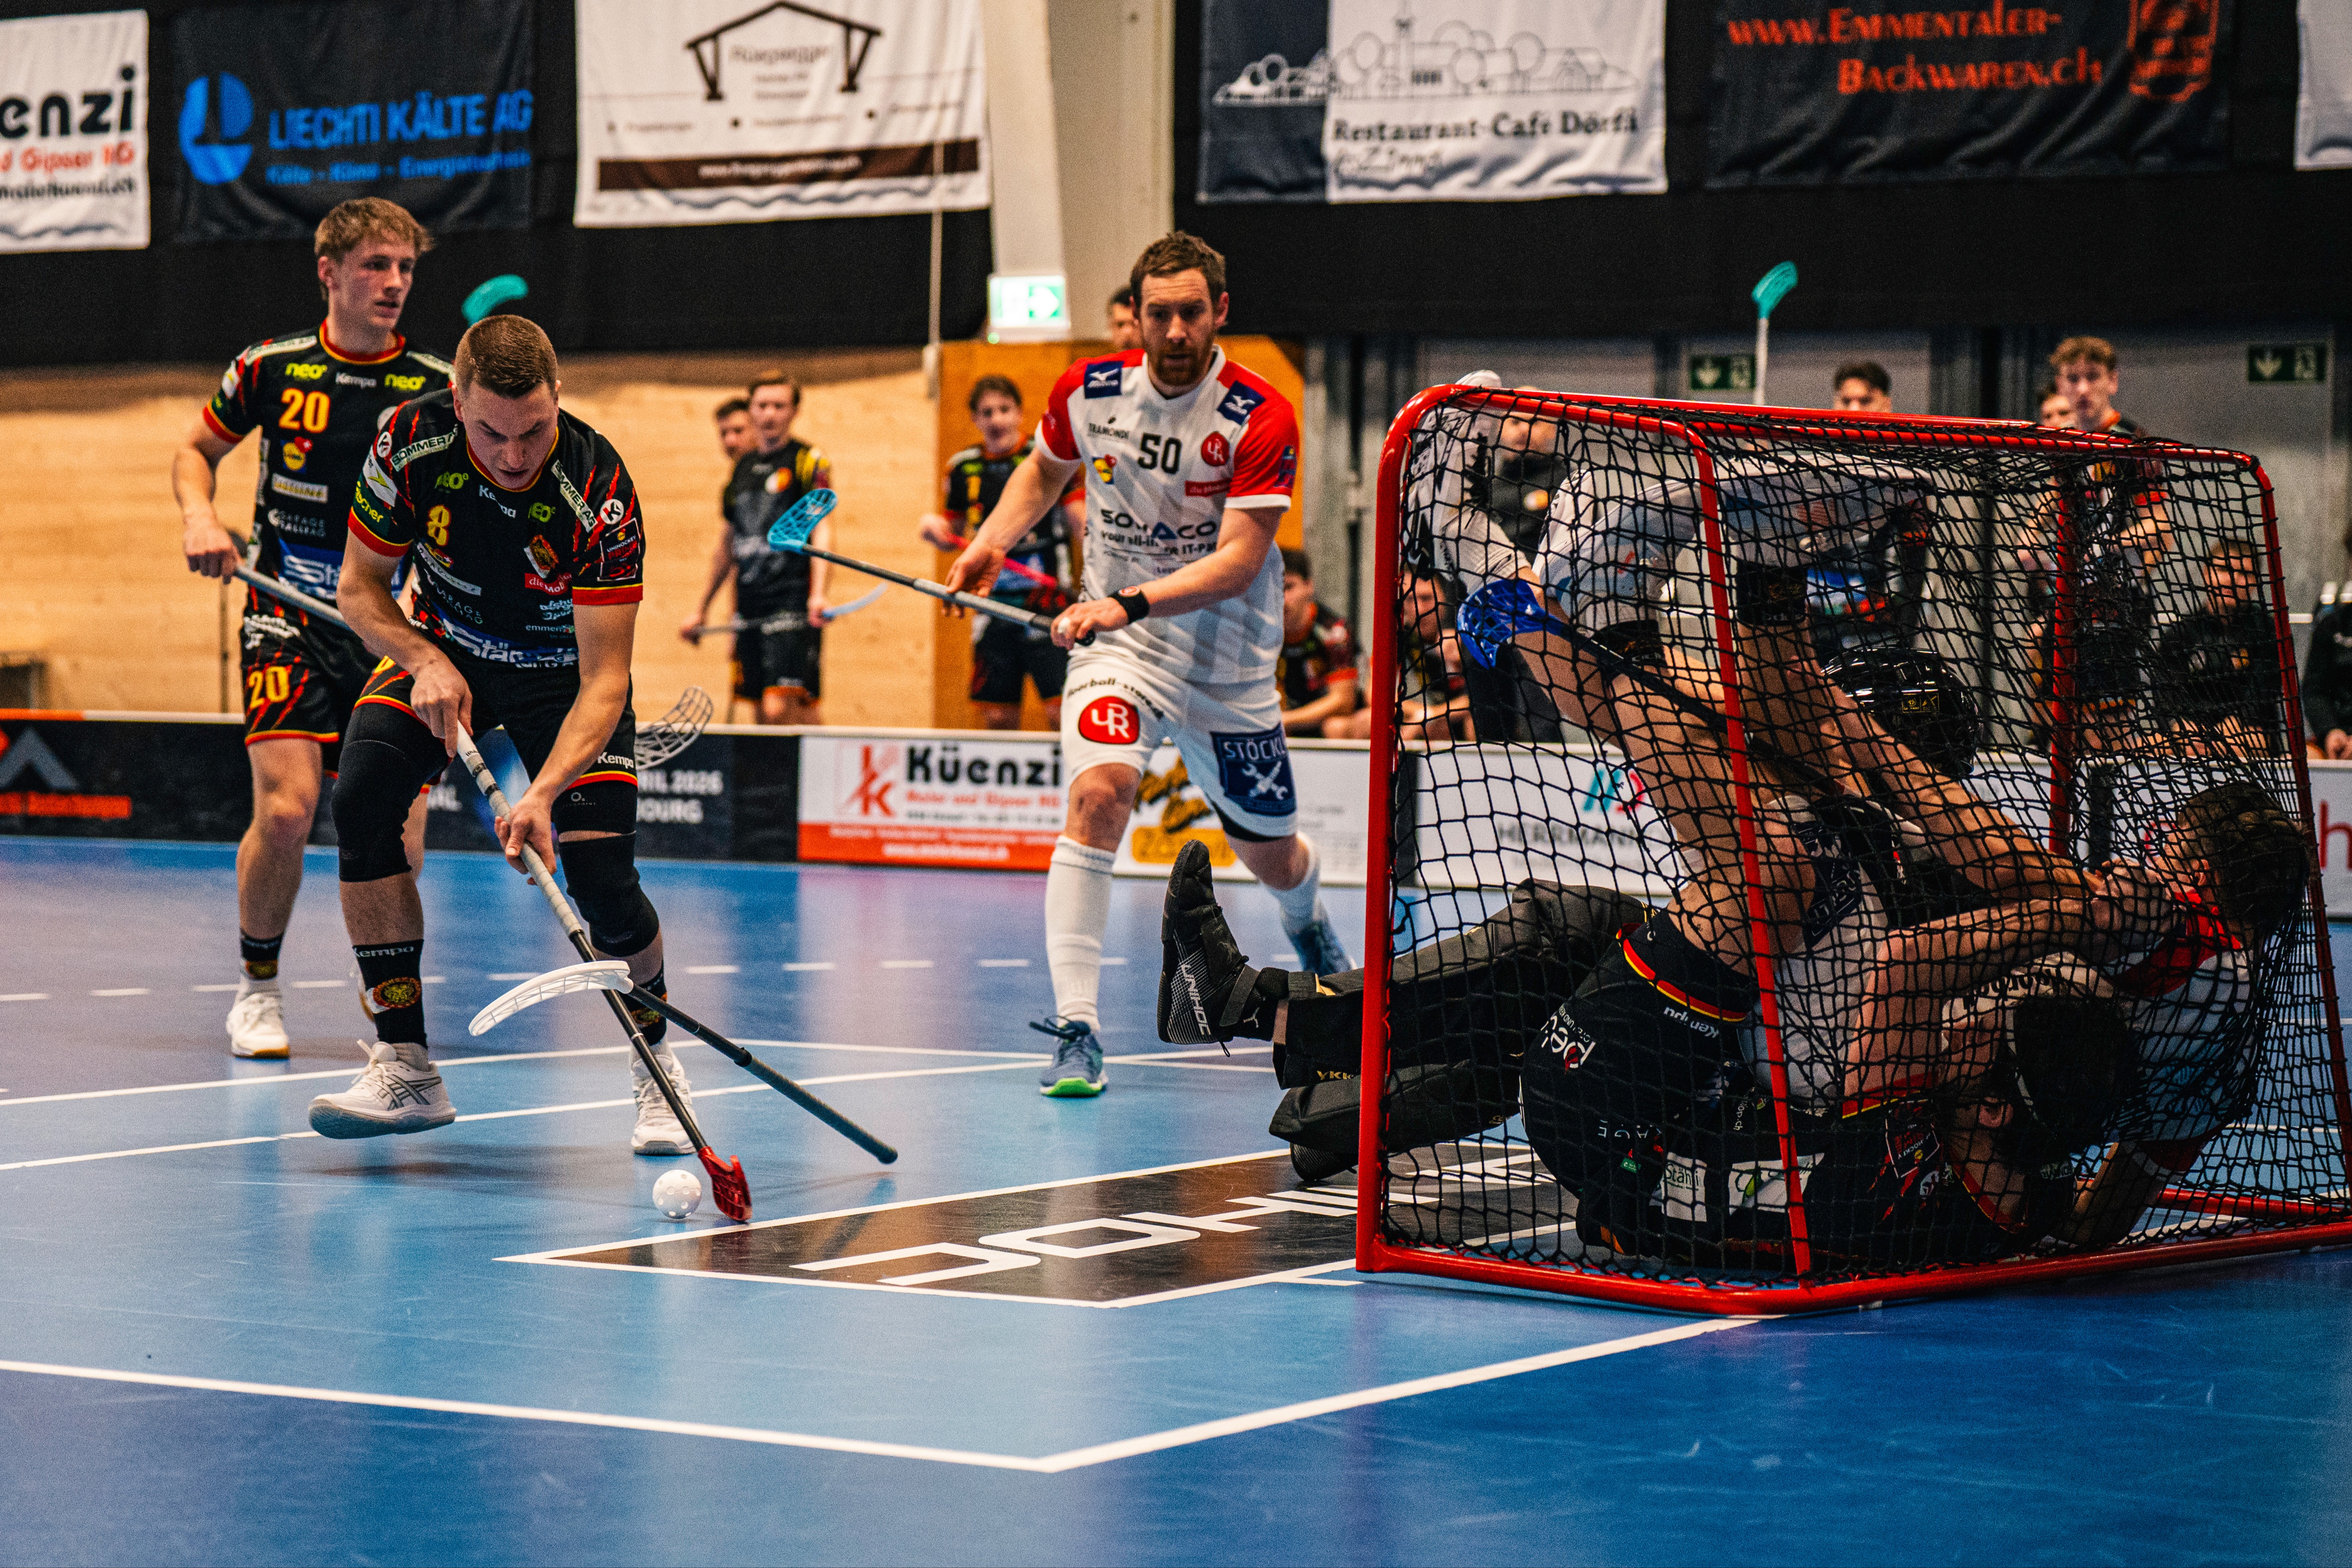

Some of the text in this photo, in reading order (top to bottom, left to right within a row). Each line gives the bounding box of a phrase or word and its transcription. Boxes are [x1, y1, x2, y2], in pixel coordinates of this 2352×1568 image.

[387, 91, 486, 142] KÄLTE
[493, 89, 533, 133] AG
[279, 387, 330, 433] 20
[392, 436, 446, 466] SOMMER
[1138, 433, 1182, 475] 50
[582, 511, 596, 527] AG
[607, 535, 636, 553] UNIHOCKEY
[529, 577, 544, 588] die
[249, 665, 290, 710] 20
[597, 751, 634, 769] Kempa
[907, 743, 1061, 787] Küenzi
[1181, 964, 1212, 1035] UNIHOC
